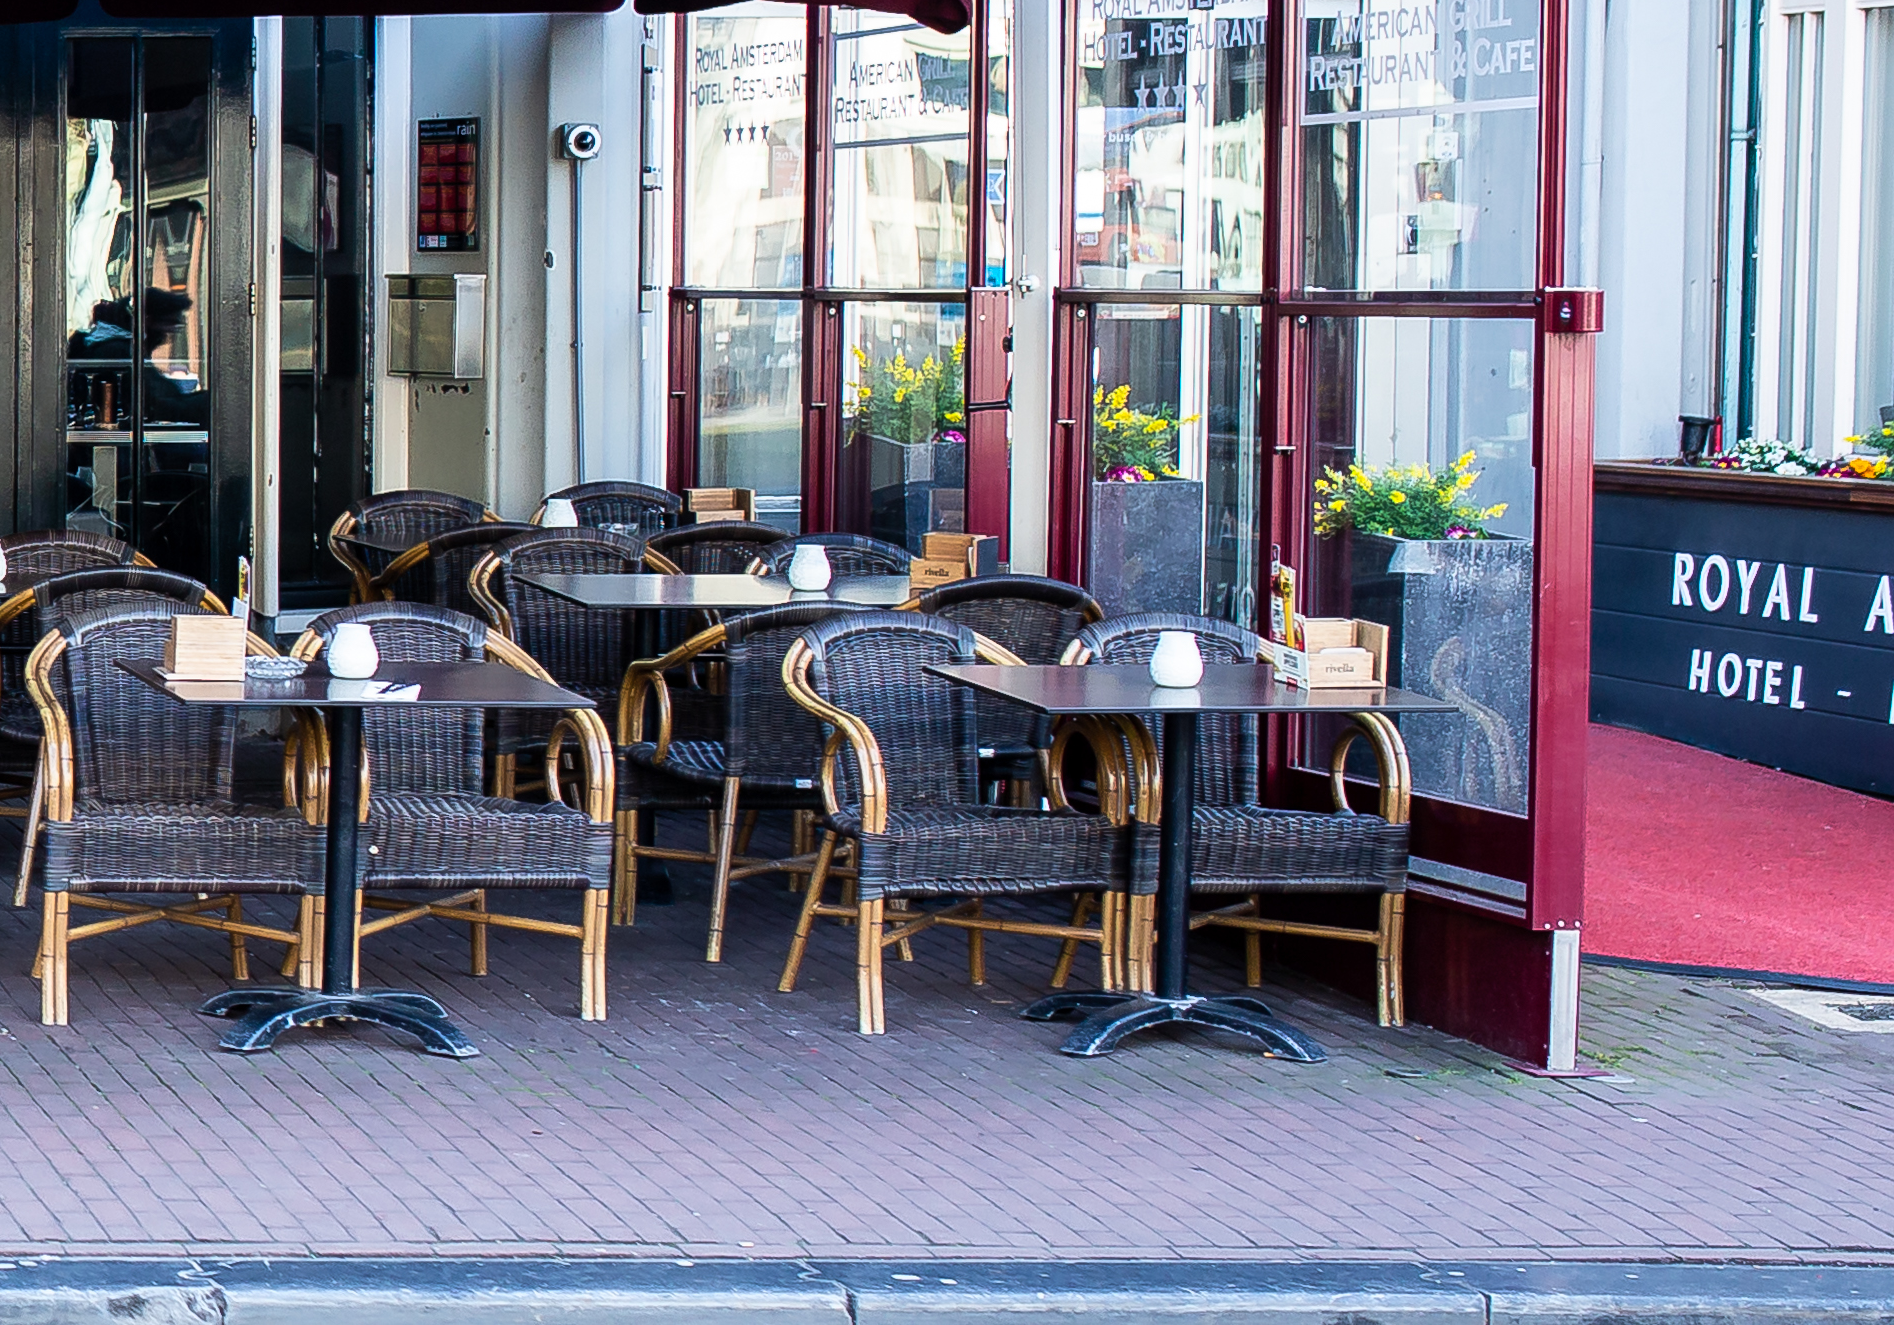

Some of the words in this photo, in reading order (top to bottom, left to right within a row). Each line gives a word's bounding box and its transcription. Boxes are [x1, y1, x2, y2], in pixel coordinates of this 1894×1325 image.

[1083, 30, 1138, 63] HOTEL
[1149, 15, 1268, 58] RESTAURANT
[1329, 4, 1439, 47] AMERICAN
[695, 47, 728, 74] ROYAL
[730, 38, 804, 71] AMSTERDAM
[848, 58, 914, 90] AMERICAN
[918, 52, 954, 81] GRILL
[1308, 47, 1441, 92] RESTAURANT
[1472, 36, 1536, 77] CAFE
[689, 80, 725, 107] HOTEL
[835, 93, 916, 124] RESTAURANT
[1671, 551, 1819, 624] ROYAL
[1688, 648, 1806, 710] HOTEL
